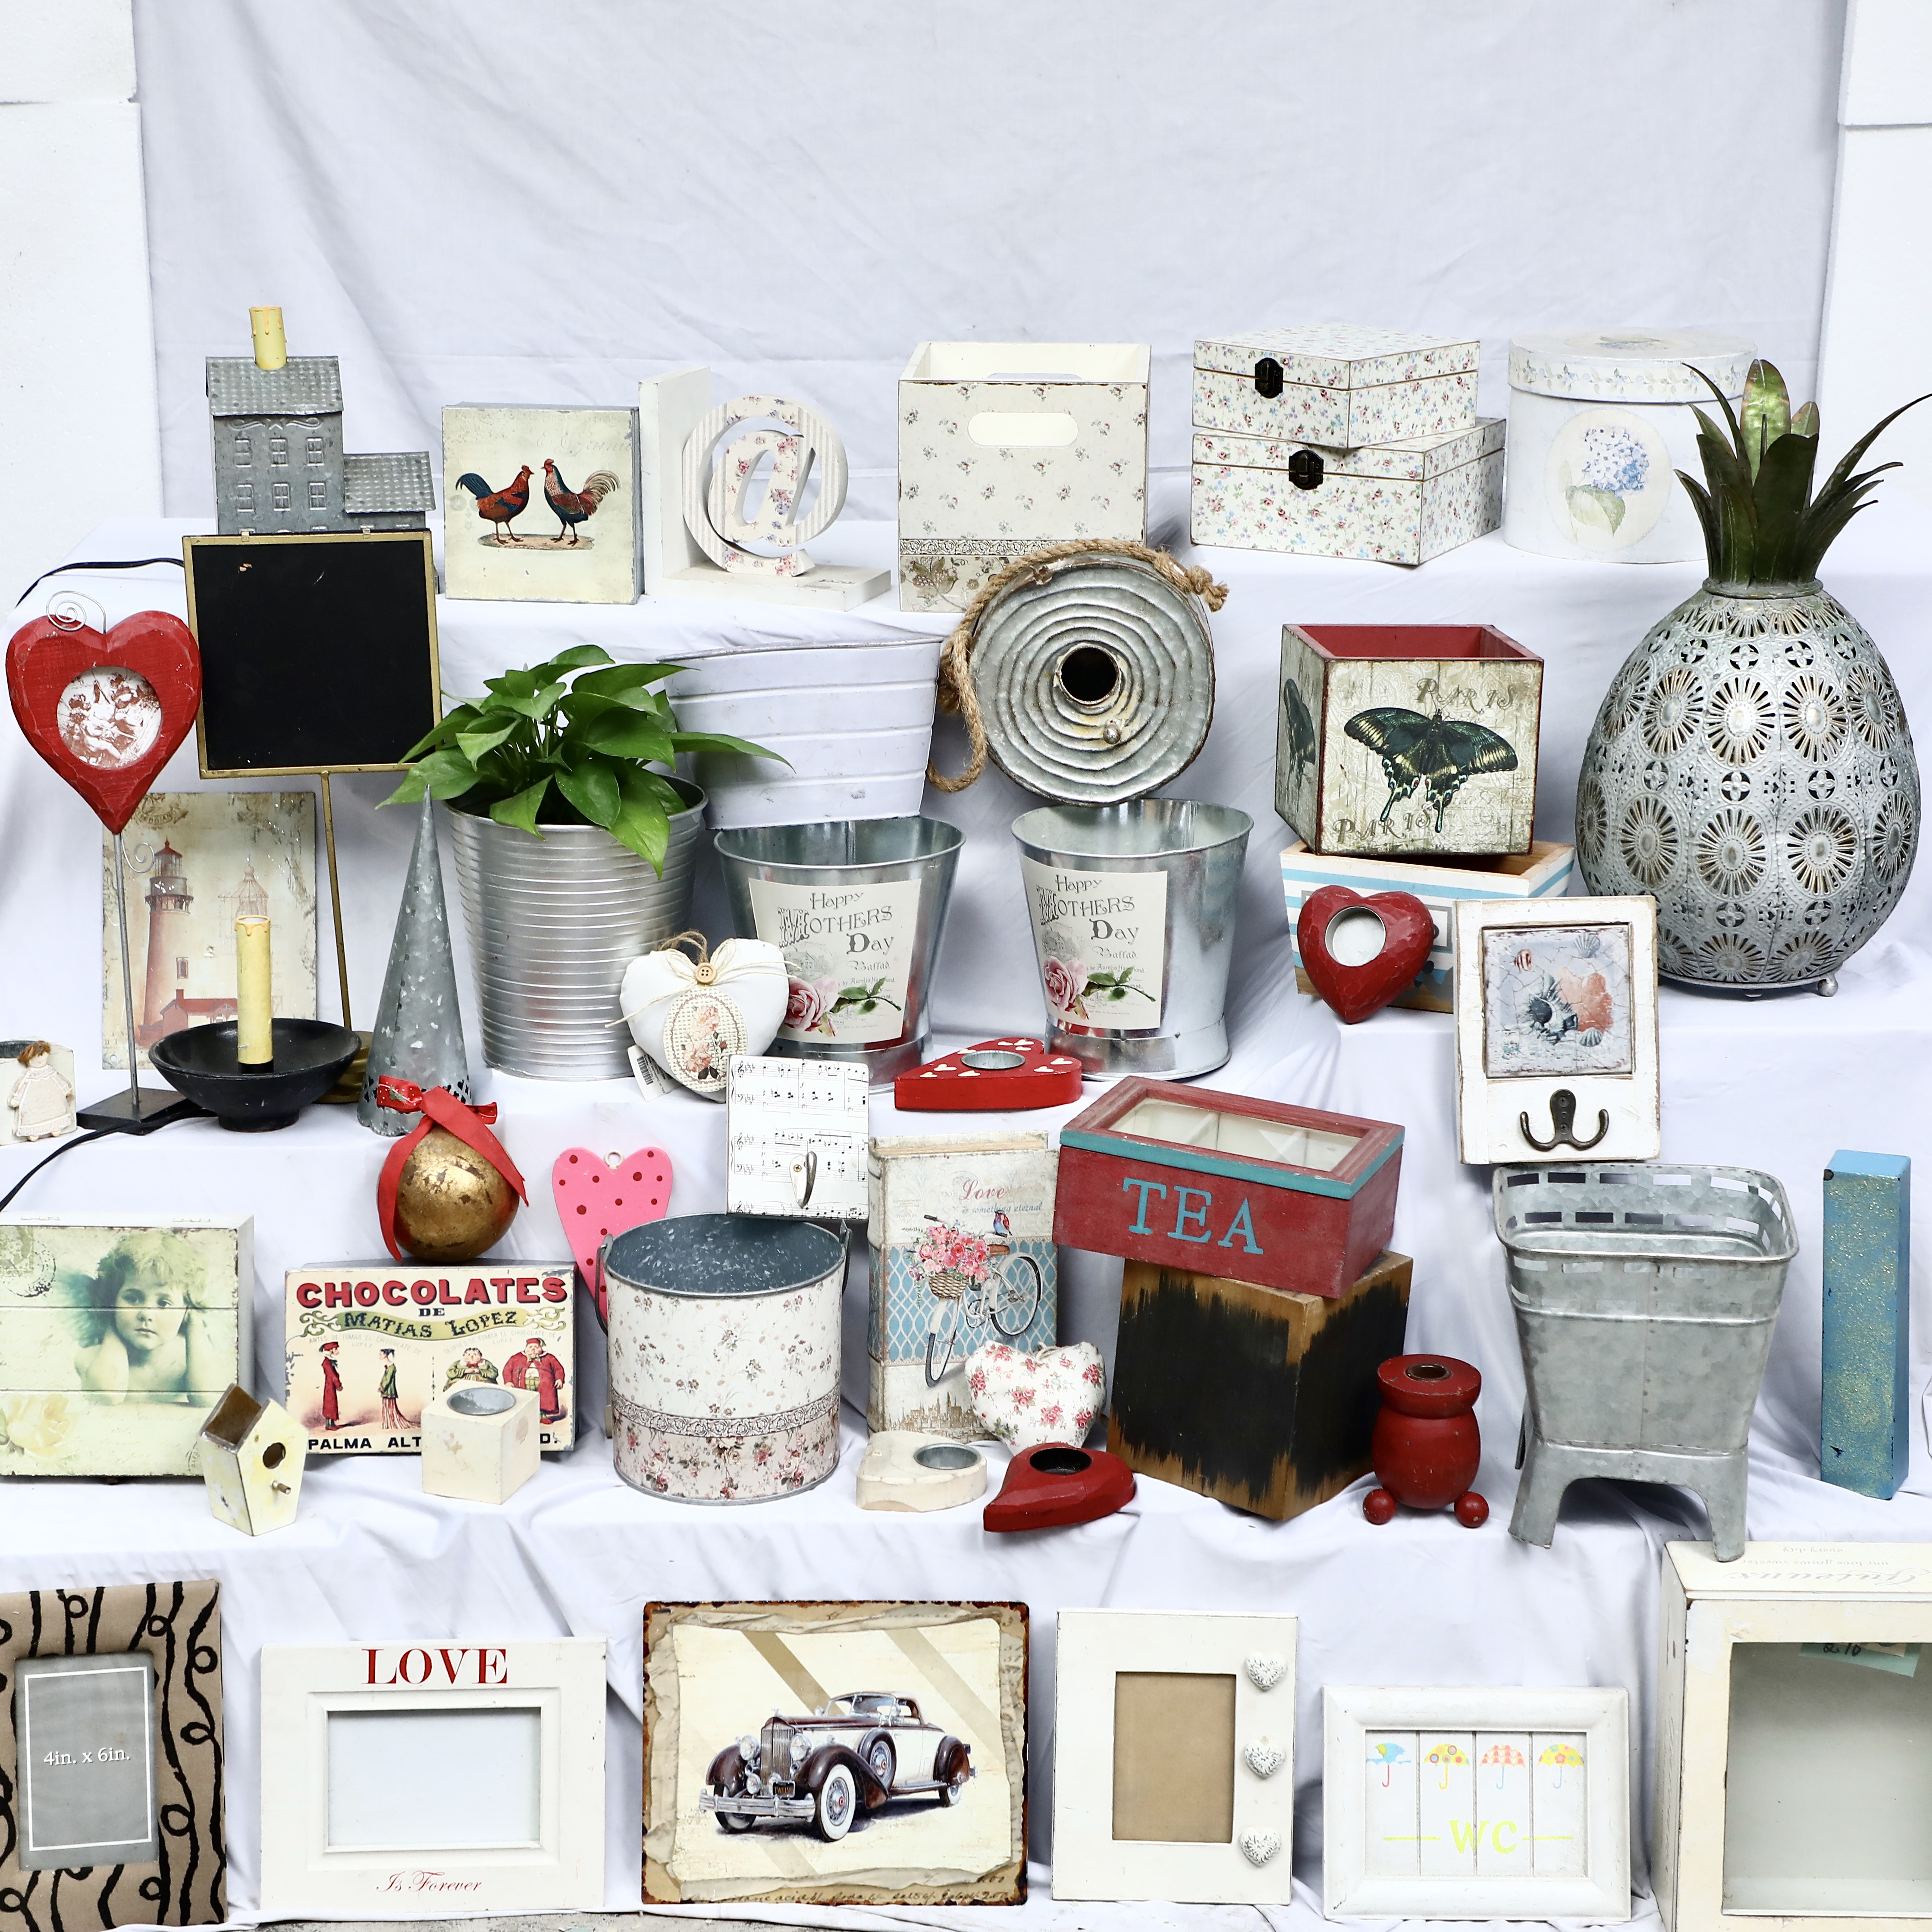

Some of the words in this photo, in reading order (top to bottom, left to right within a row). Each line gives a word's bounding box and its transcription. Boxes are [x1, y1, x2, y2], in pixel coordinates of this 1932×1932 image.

[1416, 678, 1515, 715] PARIS
[1333, 803, 1434, 844] PARIS
[1055, 874, 1102, 894] Happy
[810, 892, 864, 910] Happy
[1036, 884, 1135, 926] MOTHERS
[778, 905, 893, 949] MOTHERS
[1089, 919, 1139, 945] Day
[846, 933, 894, 955] Day
[959, 1179, 1007, 1201] Love
[1014, 1201, 1043, 1211] eternal
[1123, 1176, 1264, 1256] TEA
[297, 1277, 568, 1308] CHOCOLATES
[345, 1312, 432, 1337] MATIAS
[445, 1311, 518, 1336] LOPEZ
[418, 1308, 445, 1317] DE
[308, 1437, 372, 1449] PALMA
[388, 1437, 421, 1447] ALT
[361, 1647, 508, 1685] LOVE
[44, 1751, 77, 1766] 4in.
[82, 1752, 93, 1763] x
[97, 1747, 131, 1762] 6in.
[1448, 1819, 1518, 1854] WC
[376, 1871, 406, 1892] Is
[408, 1870, 482, 1892] Forever
